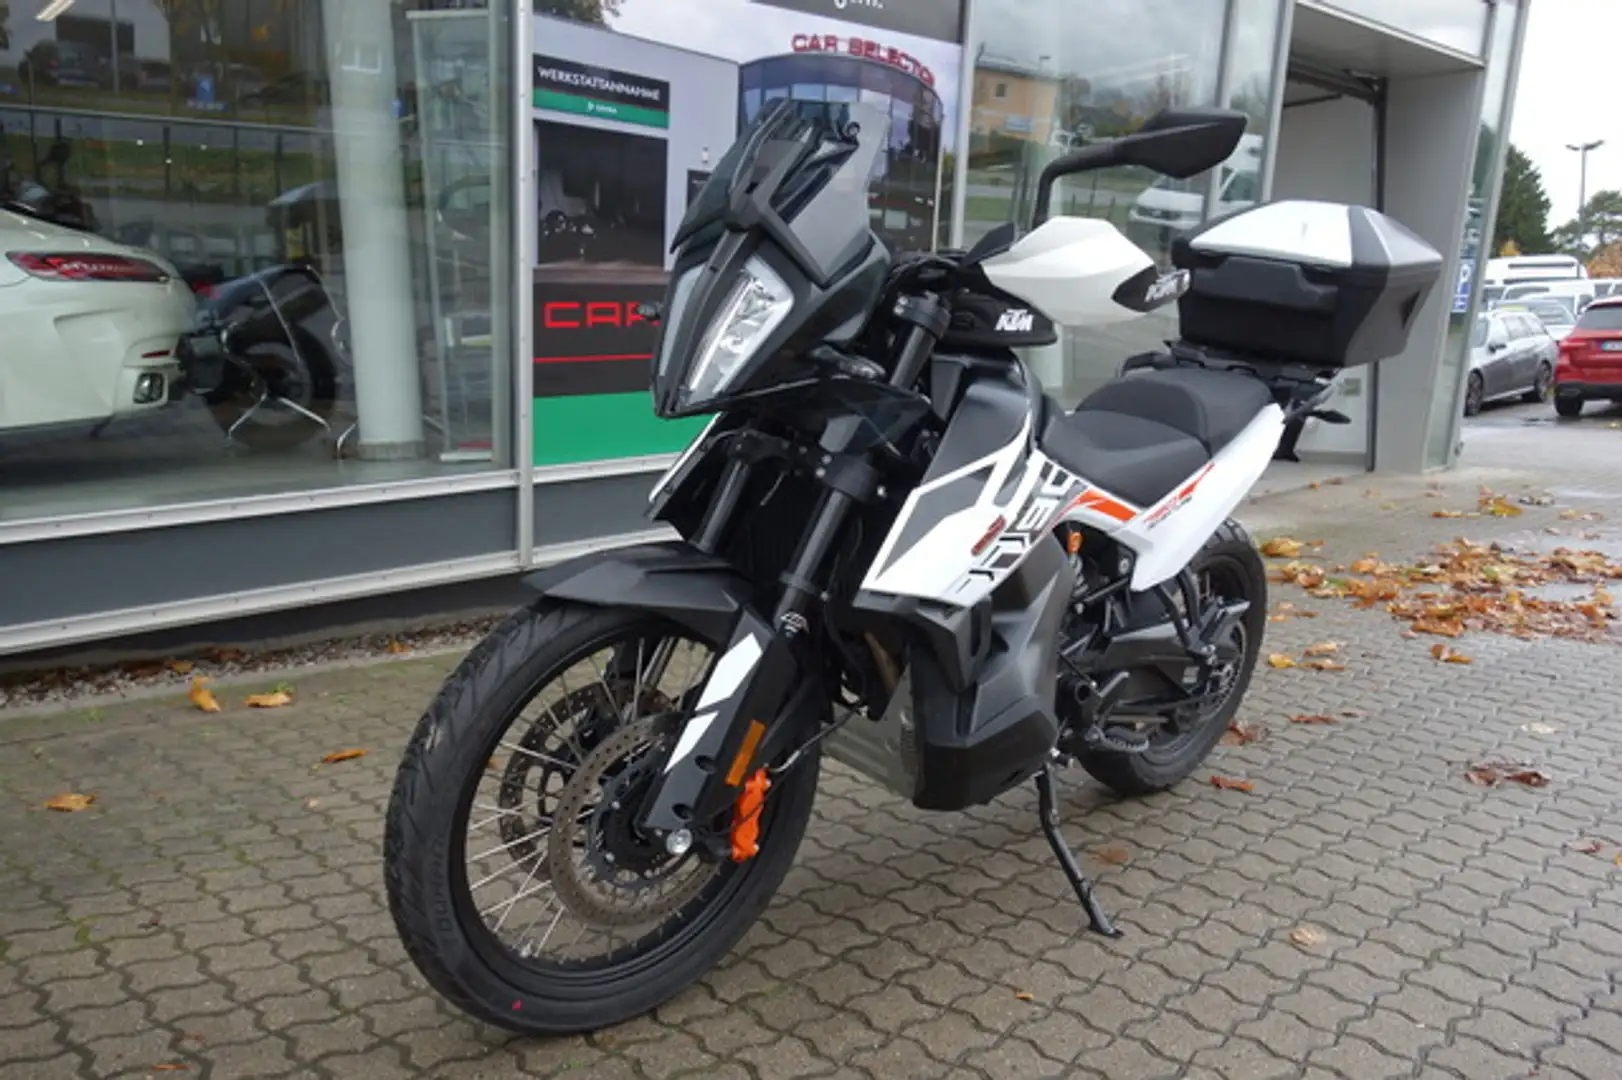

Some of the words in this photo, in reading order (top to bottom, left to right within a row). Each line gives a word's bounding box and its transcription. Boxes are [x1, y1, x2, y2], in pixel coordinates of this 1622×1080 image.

[792, 34, 837, 52] CAR
[537, 65, 660, 101] WERKSTATTANNAHME
[995, 308, 1034, 331] KTM
